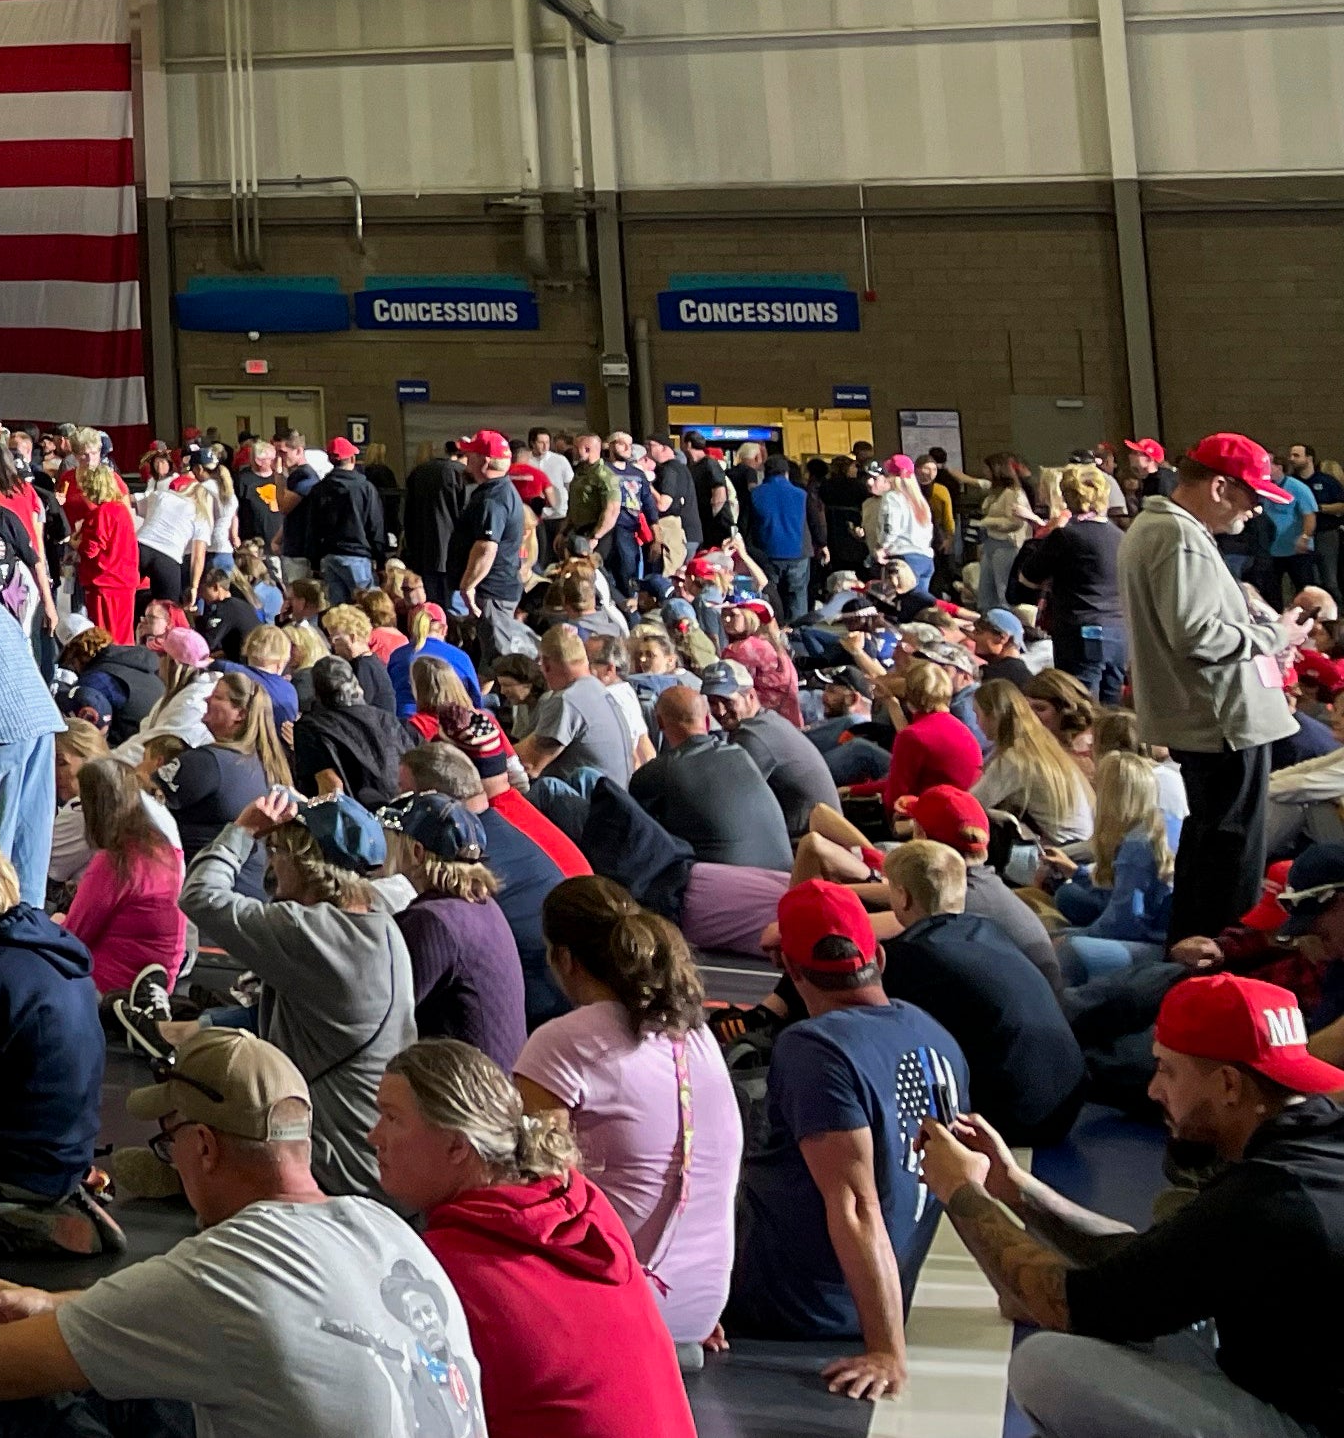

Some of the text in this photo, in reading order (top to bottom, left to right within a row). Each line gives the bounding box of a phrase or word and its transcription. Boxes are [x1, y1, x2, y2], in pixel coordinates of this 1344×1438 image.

[372, 298, 519, 324] CONCESSIONS
[678, 299, 839, 324] CONCESSIONS
[352, 423, 365, 444] B
